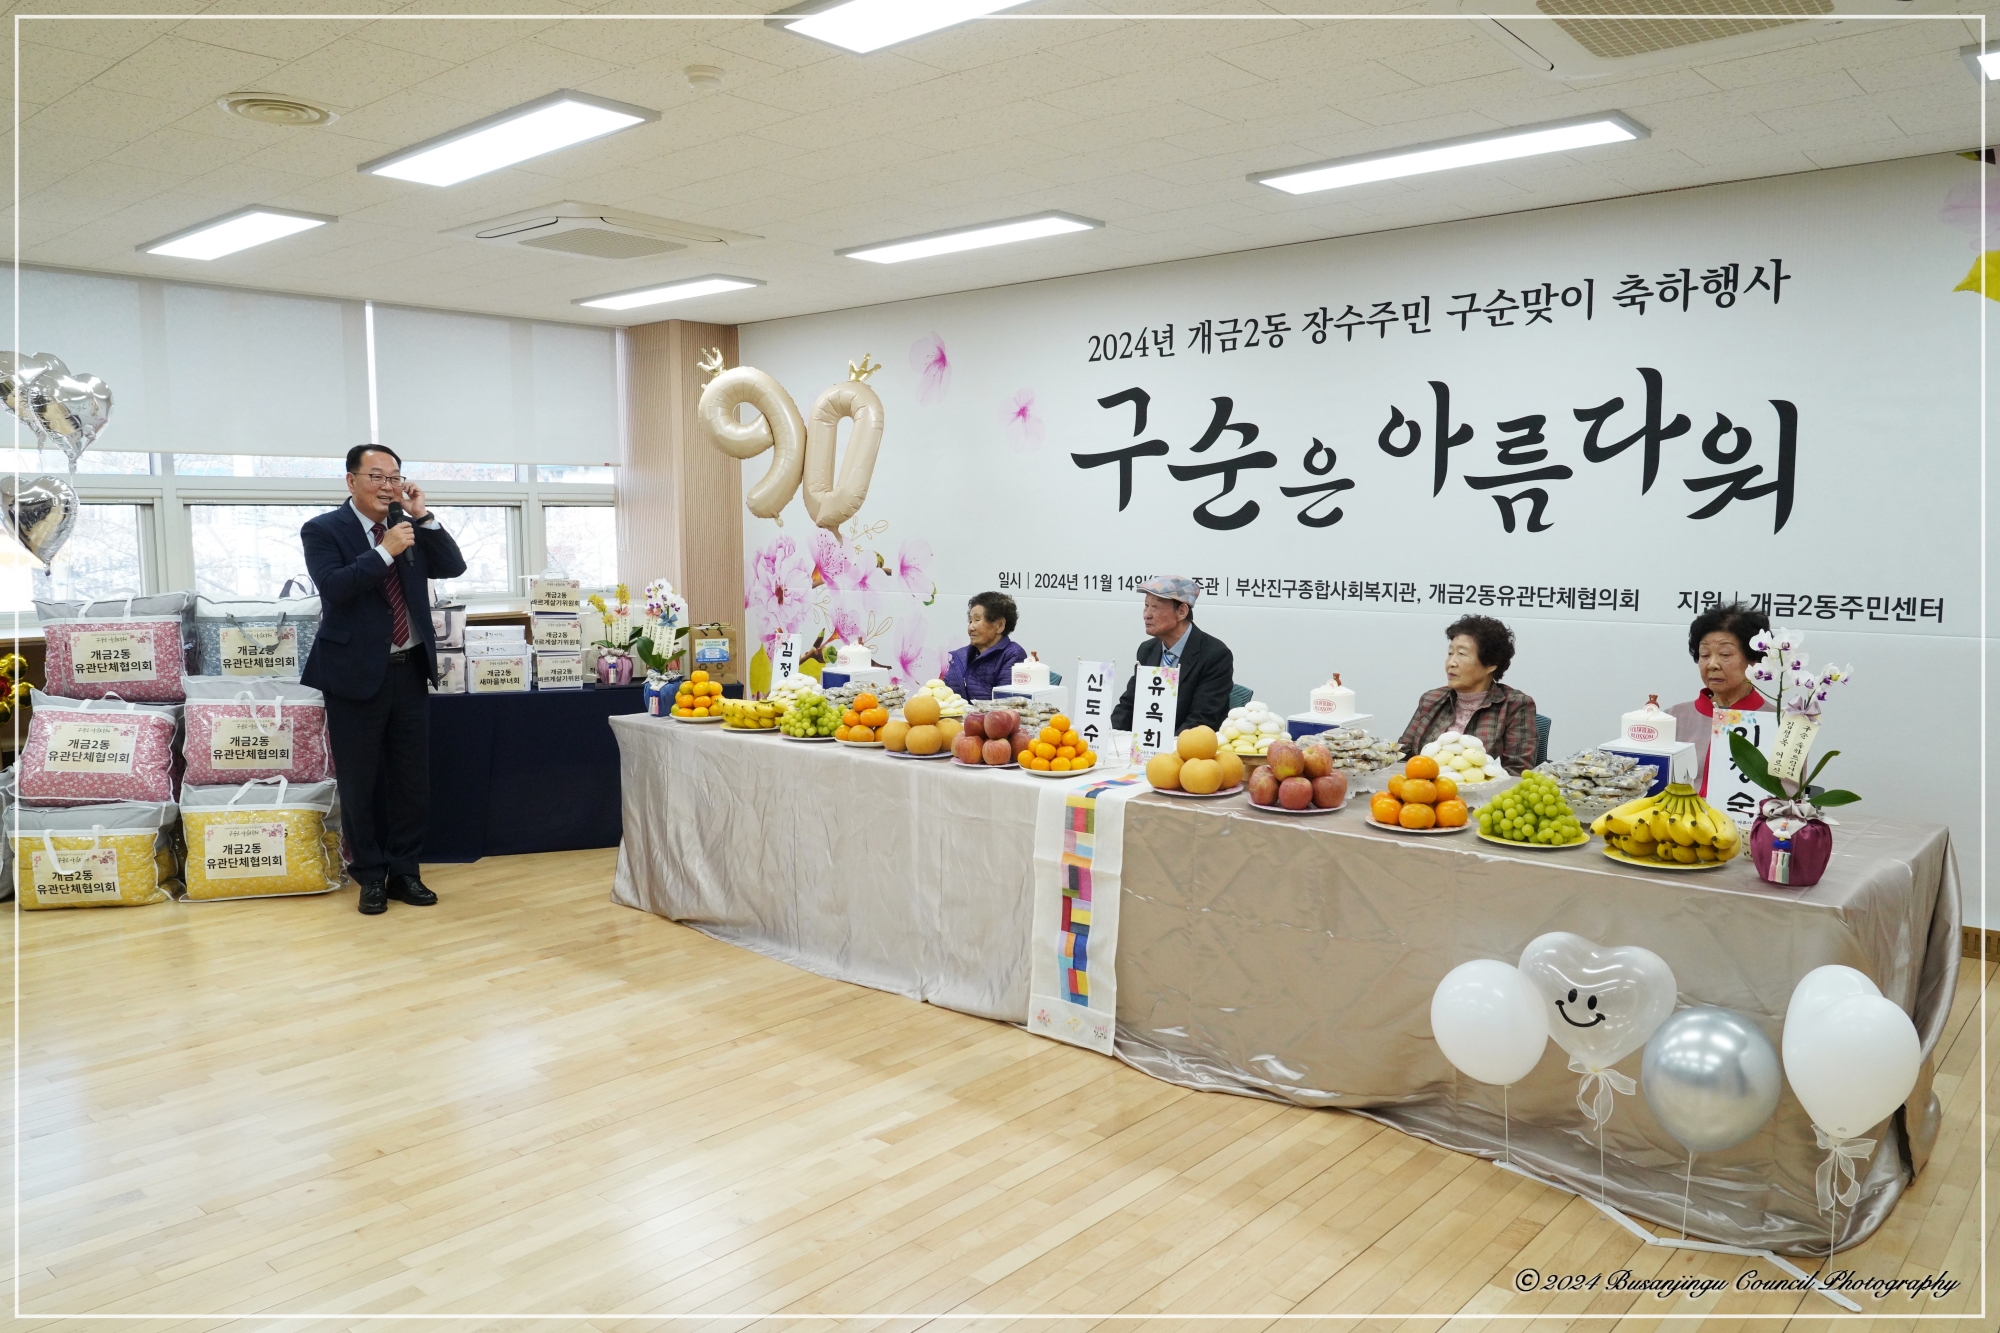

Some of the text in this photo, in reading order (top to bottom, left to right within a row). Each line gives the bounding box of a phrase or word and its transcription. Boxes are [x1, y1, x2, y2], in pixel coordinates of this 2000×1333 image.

[1088, 258, 1792, 363] 2024년 개금2동 장수주민 구순맞이 축하행사
[1070, 367, 1800, 536] 구순은 아름다워
[545, 591, 567, 599] 개금2동
[998, 571, 1021, 589] 일시
[1034, 573, 1078, 591] 2024년
[1084, 575, 1112, 592] 11월
[1235, 578, 1421, 604] 부산진구종합사회복지관,
[1428, 583, 1640, 612] 개금2동유관단체협의회
[1750, 592, 1944, 623] 개금2동주민센터
[91, 649, 131, 660] 개금2동
[75, 660, 152, 674] 유관단체협의회
[222, 656, 295, 669] 유관단체협의회
[487, 669, 512, 677] 개금2동
[479, 677, 520, 686] 새마을부녀회
[1084, 673, 1104, 742] 신도수
[1142, 676, 1166, 749] 유옥희
[68, 739, 110, 750] 개금2동
[230, 736, 269, 747] 개금2동
[48, 751, 130, 763] 유관단체협의회
[213, 749, 289, 760] 유관단체협의회
[222, 843, 262, 855] 개금2동
[206, 855, 283, 870] 유관단체협의회
[37, 882, 116, 895] 유관단체협의회
